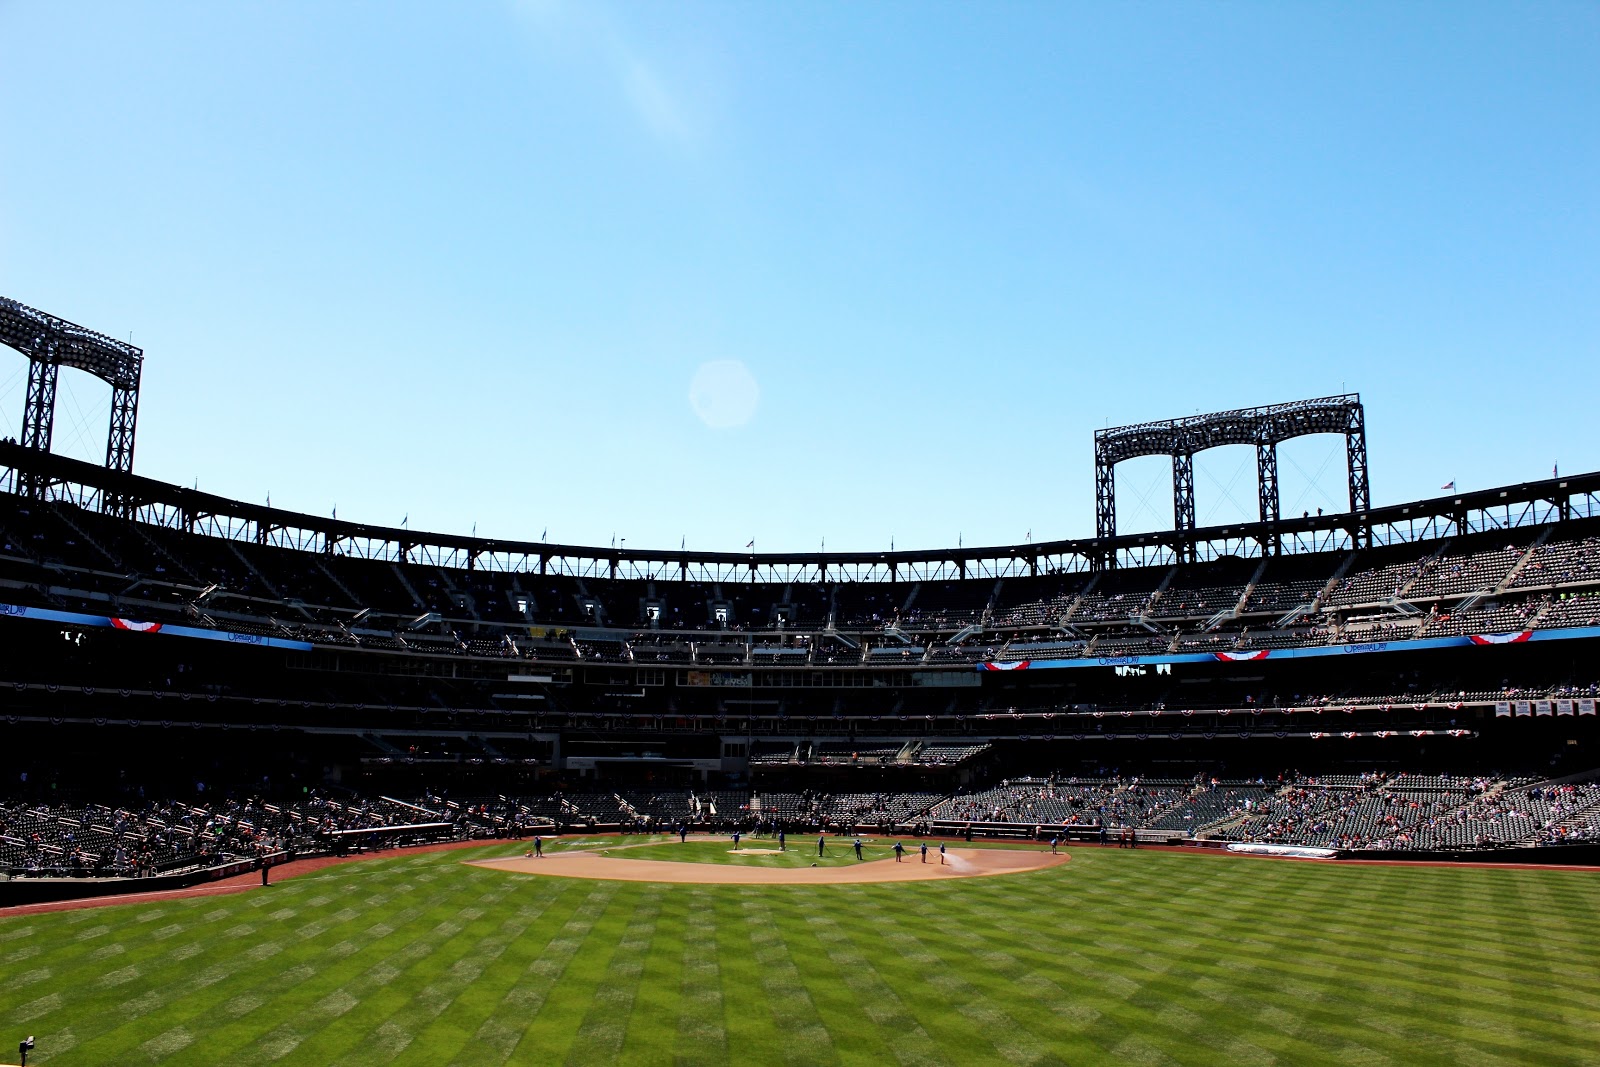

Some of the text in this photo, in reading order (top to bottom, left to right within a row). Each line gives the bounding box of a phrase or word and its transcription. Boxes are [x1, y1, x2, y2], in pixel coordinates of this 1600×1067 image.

[10, 605, 26, 616] Day
[228, 632, 251, 643] Opening
[1344, 643, 1388, 653] Opening Day
[1099, 656, 1139, 665] Opening Day
